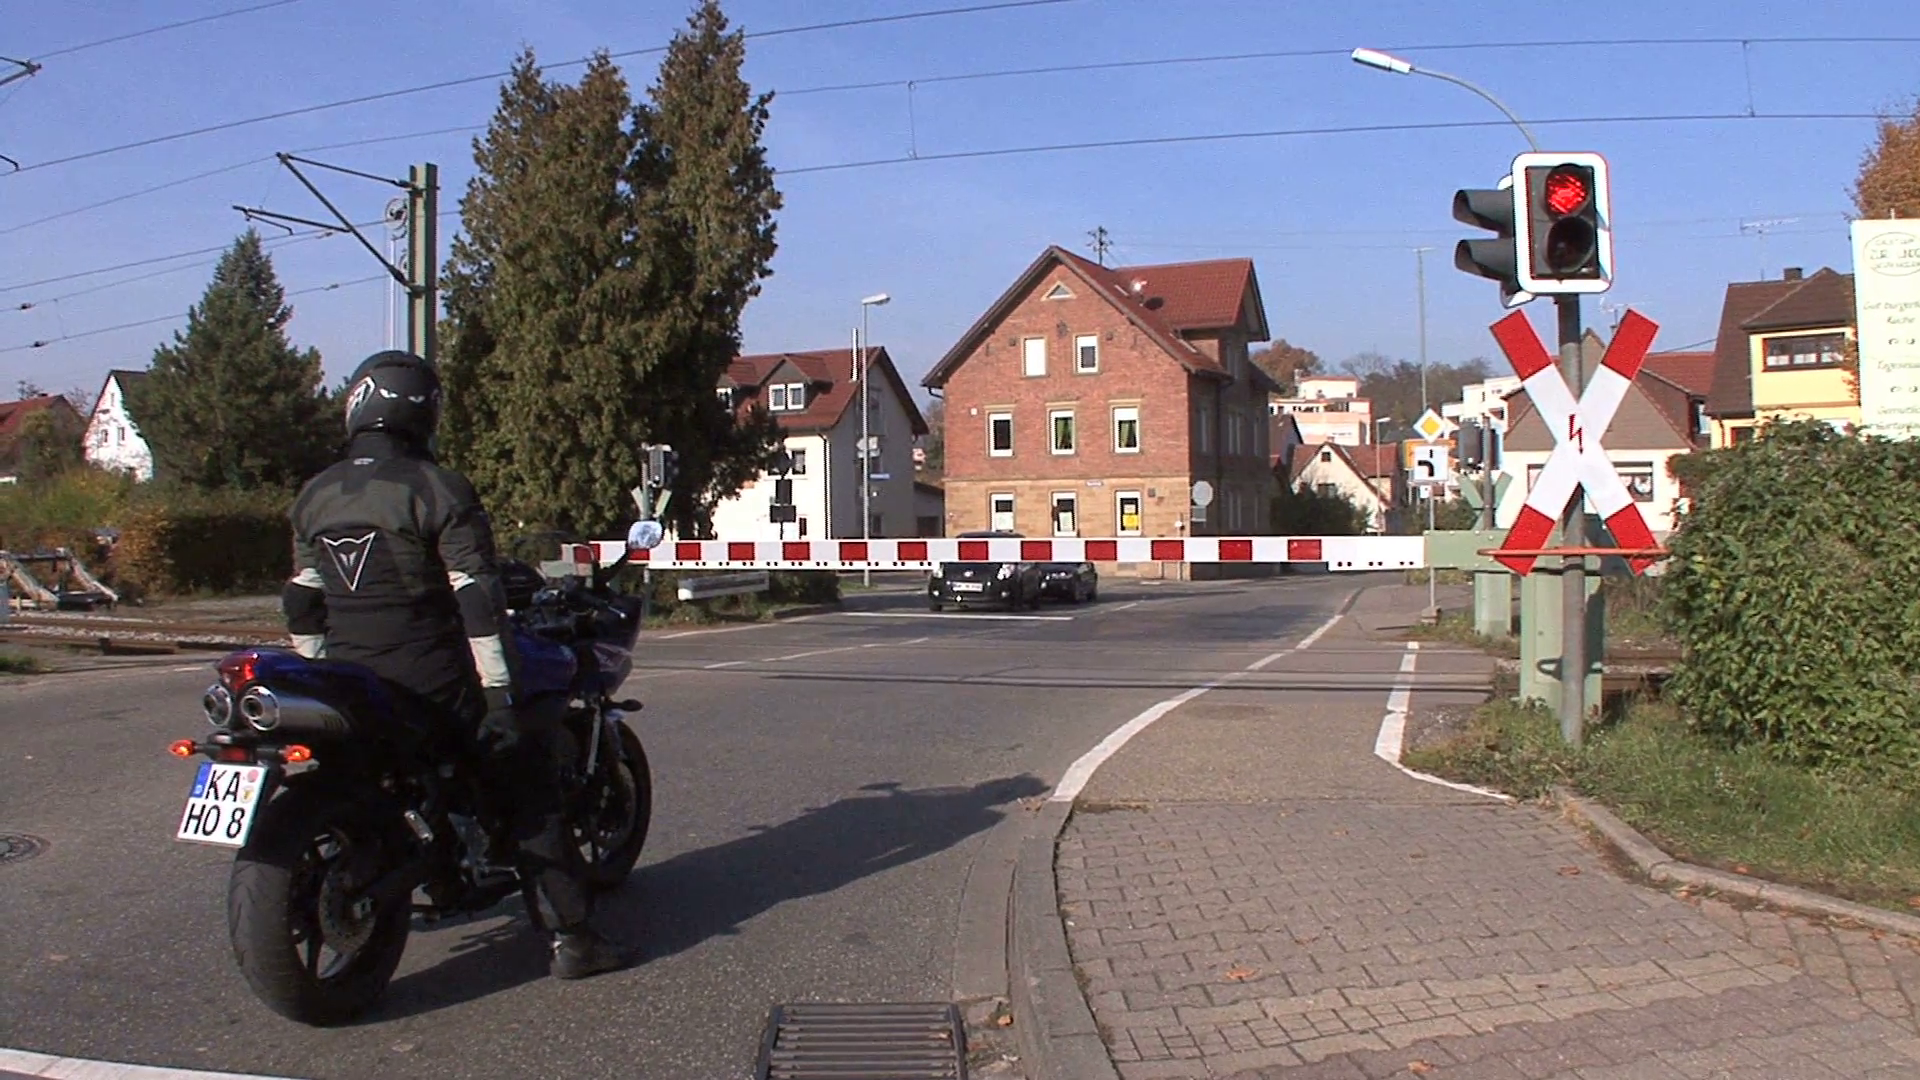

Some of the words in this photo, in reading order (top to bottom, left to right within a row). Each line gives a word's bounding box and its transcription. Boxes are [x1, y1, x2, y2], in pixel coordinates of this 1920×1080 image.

[205, 769, 241, 802] KA
[183, 802, 221, 836] HO
[226, 807, 246, 839] 8
